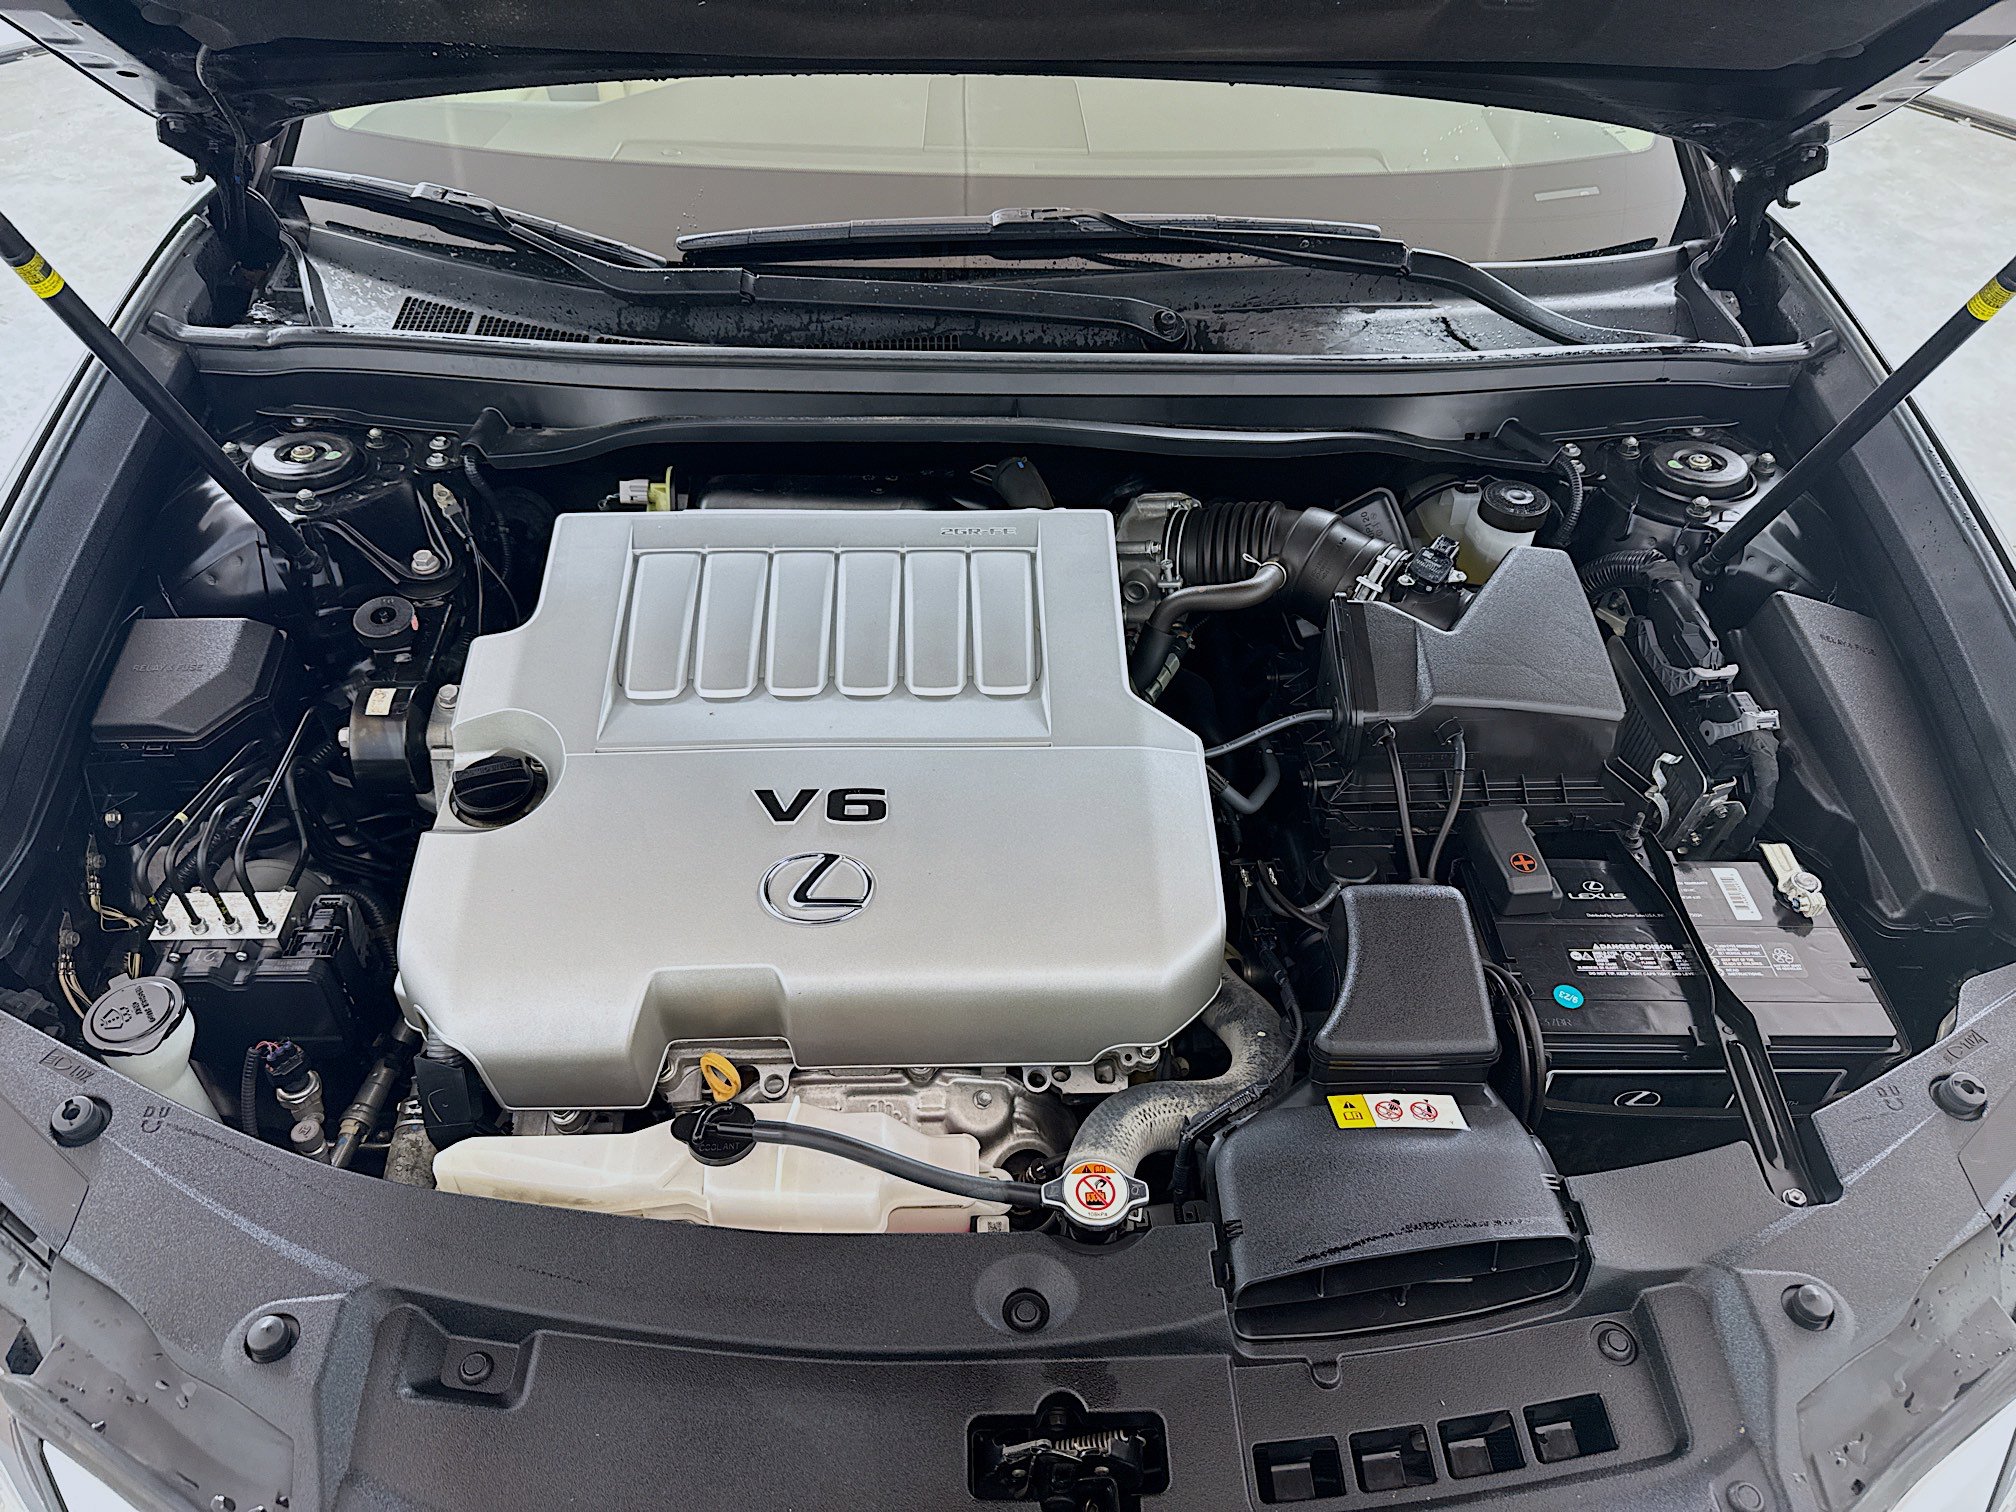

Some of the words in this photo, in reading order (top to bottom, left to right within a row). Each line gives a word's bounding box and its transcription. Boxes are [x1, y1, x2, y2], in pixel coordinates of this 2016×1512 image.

[941, 527, 1017, 535] 2GR-FE
[751, 787, 889, 825] V6
[1567, 892, 1627, 900] LEXUS
[1559, 990, 1579, 1004] 9/23
[699, 1142, 740, 1152] COOLANT
